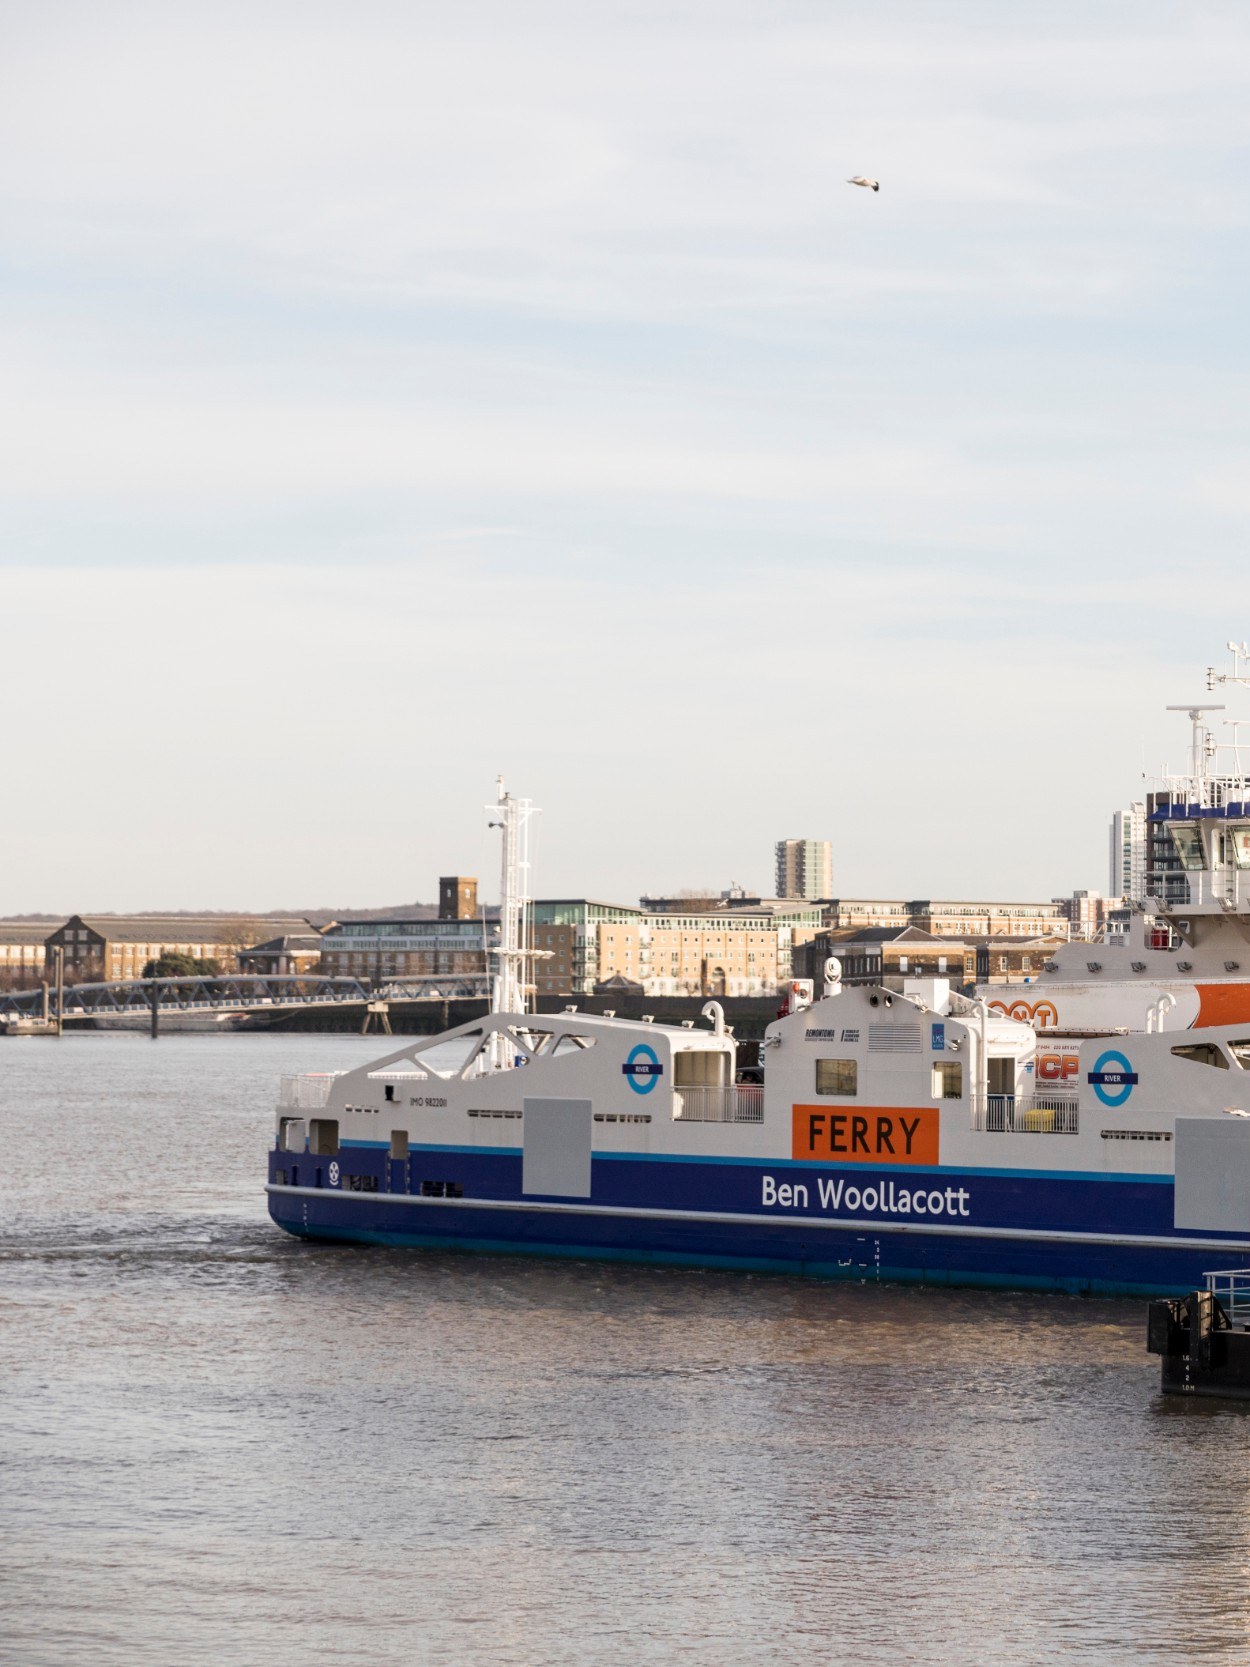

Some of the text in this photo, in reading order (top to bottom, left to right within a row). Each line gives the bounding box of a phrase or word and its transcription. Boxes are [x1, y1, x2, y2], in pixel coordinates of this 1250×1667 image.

[932, 1035, 944, 1043] LMG
[1104, 1074, 1121, 1082] RIVER
[410, 1097, 424, 1107] IMO
[809, 1114, 921, 1155] FERRY
[762, 1175, 970, 1216] Ben Woollacott
